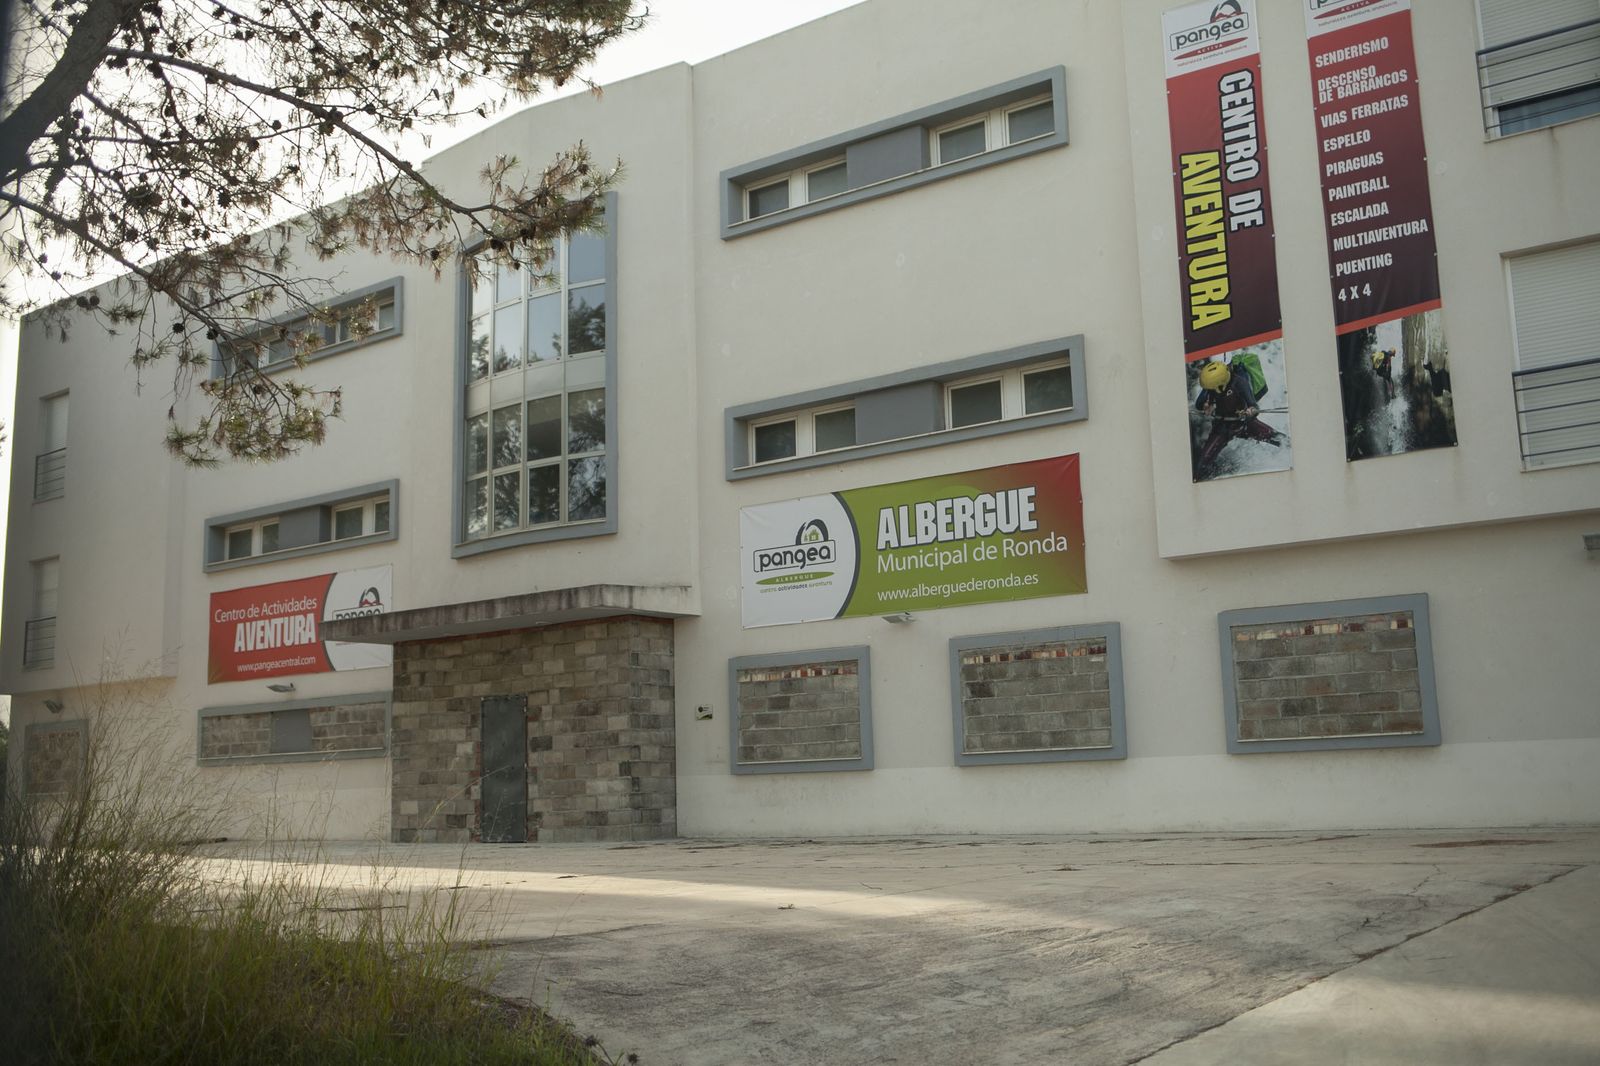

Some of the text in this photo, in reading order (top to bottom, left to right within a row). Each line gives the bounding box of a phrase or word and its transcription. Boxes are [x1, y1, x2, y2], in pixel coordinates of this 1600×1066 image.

[1341, 1, 1370, 12] ACTIVA
[1175, 18, 1244, 49] pangea
[1315, 36, 1389, 68] SENDERISMO
[1318, 65, 1377, 92] DESCENSO
[1319, 69, 1408, 104] DE BARRANCOS
[1320, 94, 1409, 128] VIAS FERRATAS
[1219, 69, 1260, 183] CENTRO
[1323, 129, 1371, 152] ESPELEO
[1326, 152, 1384, 177] PIRAGUAS
[1328, 176, 1390, 201] PAINTBALL
[1228, 189, 1264, 232] DE
[1330, 201, 1389, 226] ESCALADA
[1180, 151, 1232, 330] AVENTURA
[1333, 219, 1428, 251] MULTIAVENTURA
[1335, 253, 1393, 277] PUENTING
[877, 486, 1038, 550] ALBERGUE
[759, 545, 831, 572] pangea
[877, 532, 1068, 573] Municipal de Ronda
[877, 573, 1039, 601] www.alberguederonda.es
[214, 596, 317, 623] Centro de Actividades
[234, 613, 317, 653] AVENTURA
[237, 655, 316, 673] www.pangeacentral.com
